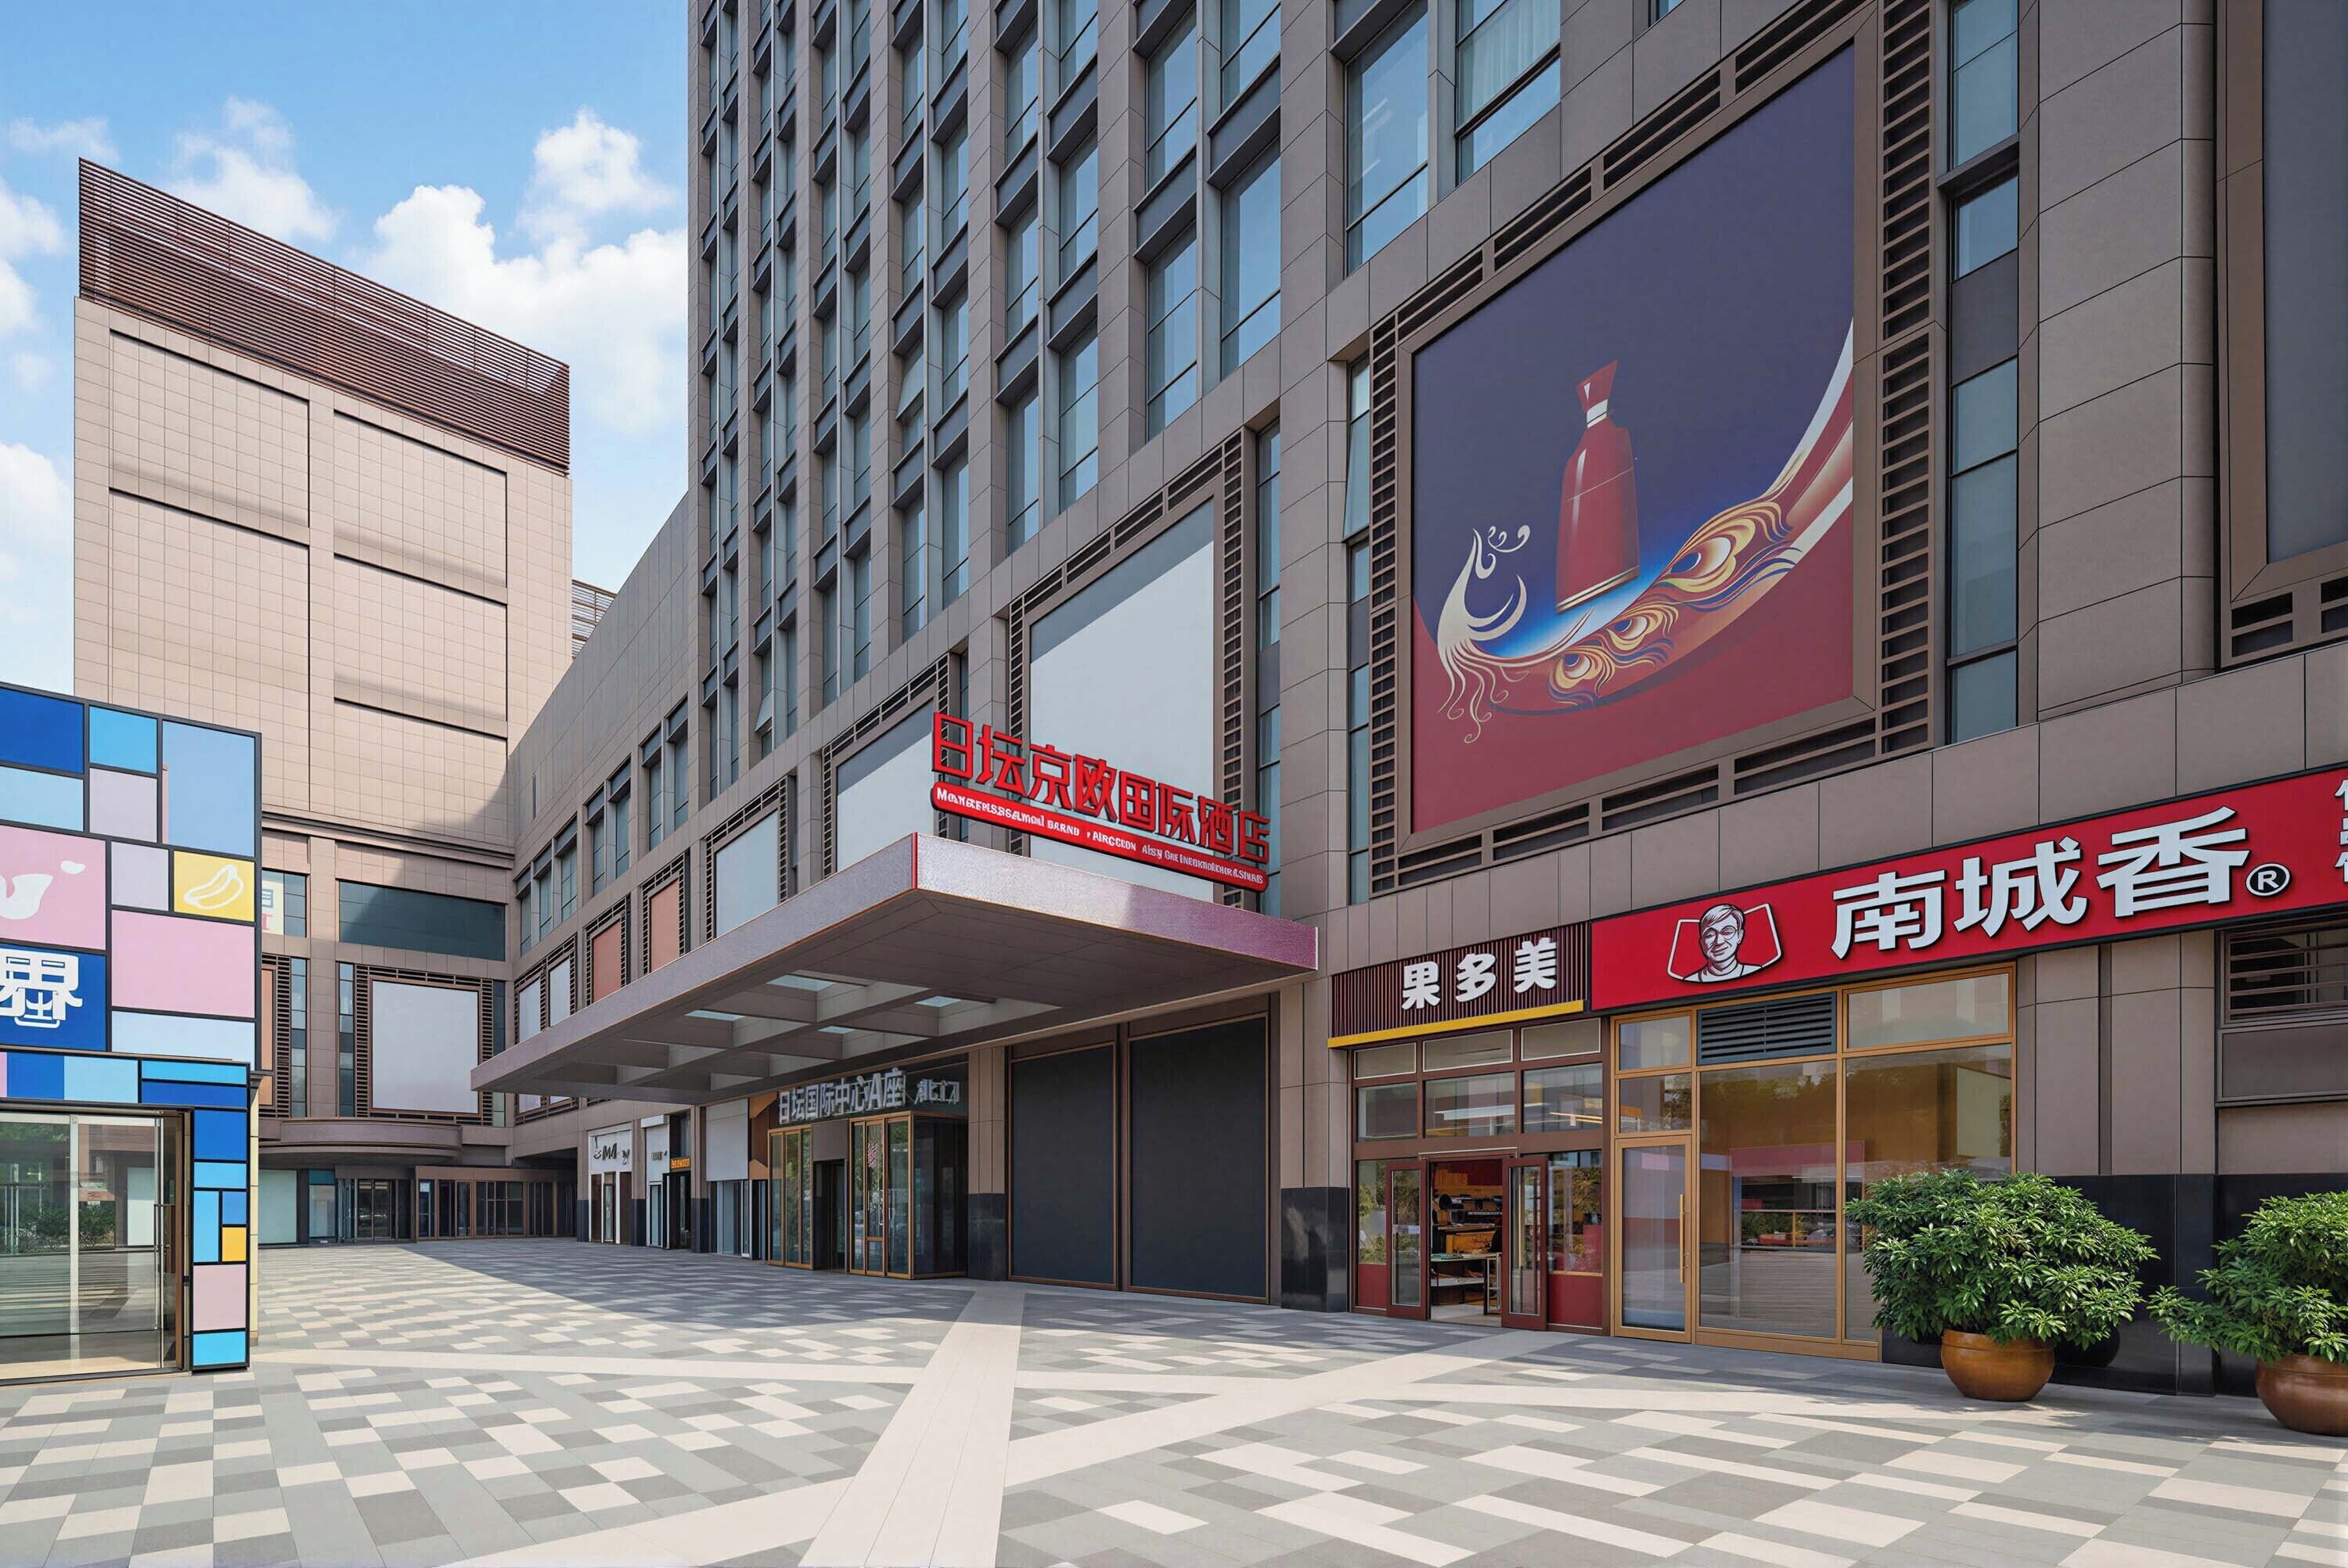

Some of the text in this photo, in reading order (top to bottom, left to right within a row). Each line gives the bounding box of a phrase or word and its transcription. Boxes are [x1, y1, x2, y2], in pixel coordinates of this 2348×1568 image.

[1830, 806, 2251, 960] 南城香
[1402, 937, 1557, 1010] 果多美
[779, 1067, 906, 1125] 日坛国际中心A座
